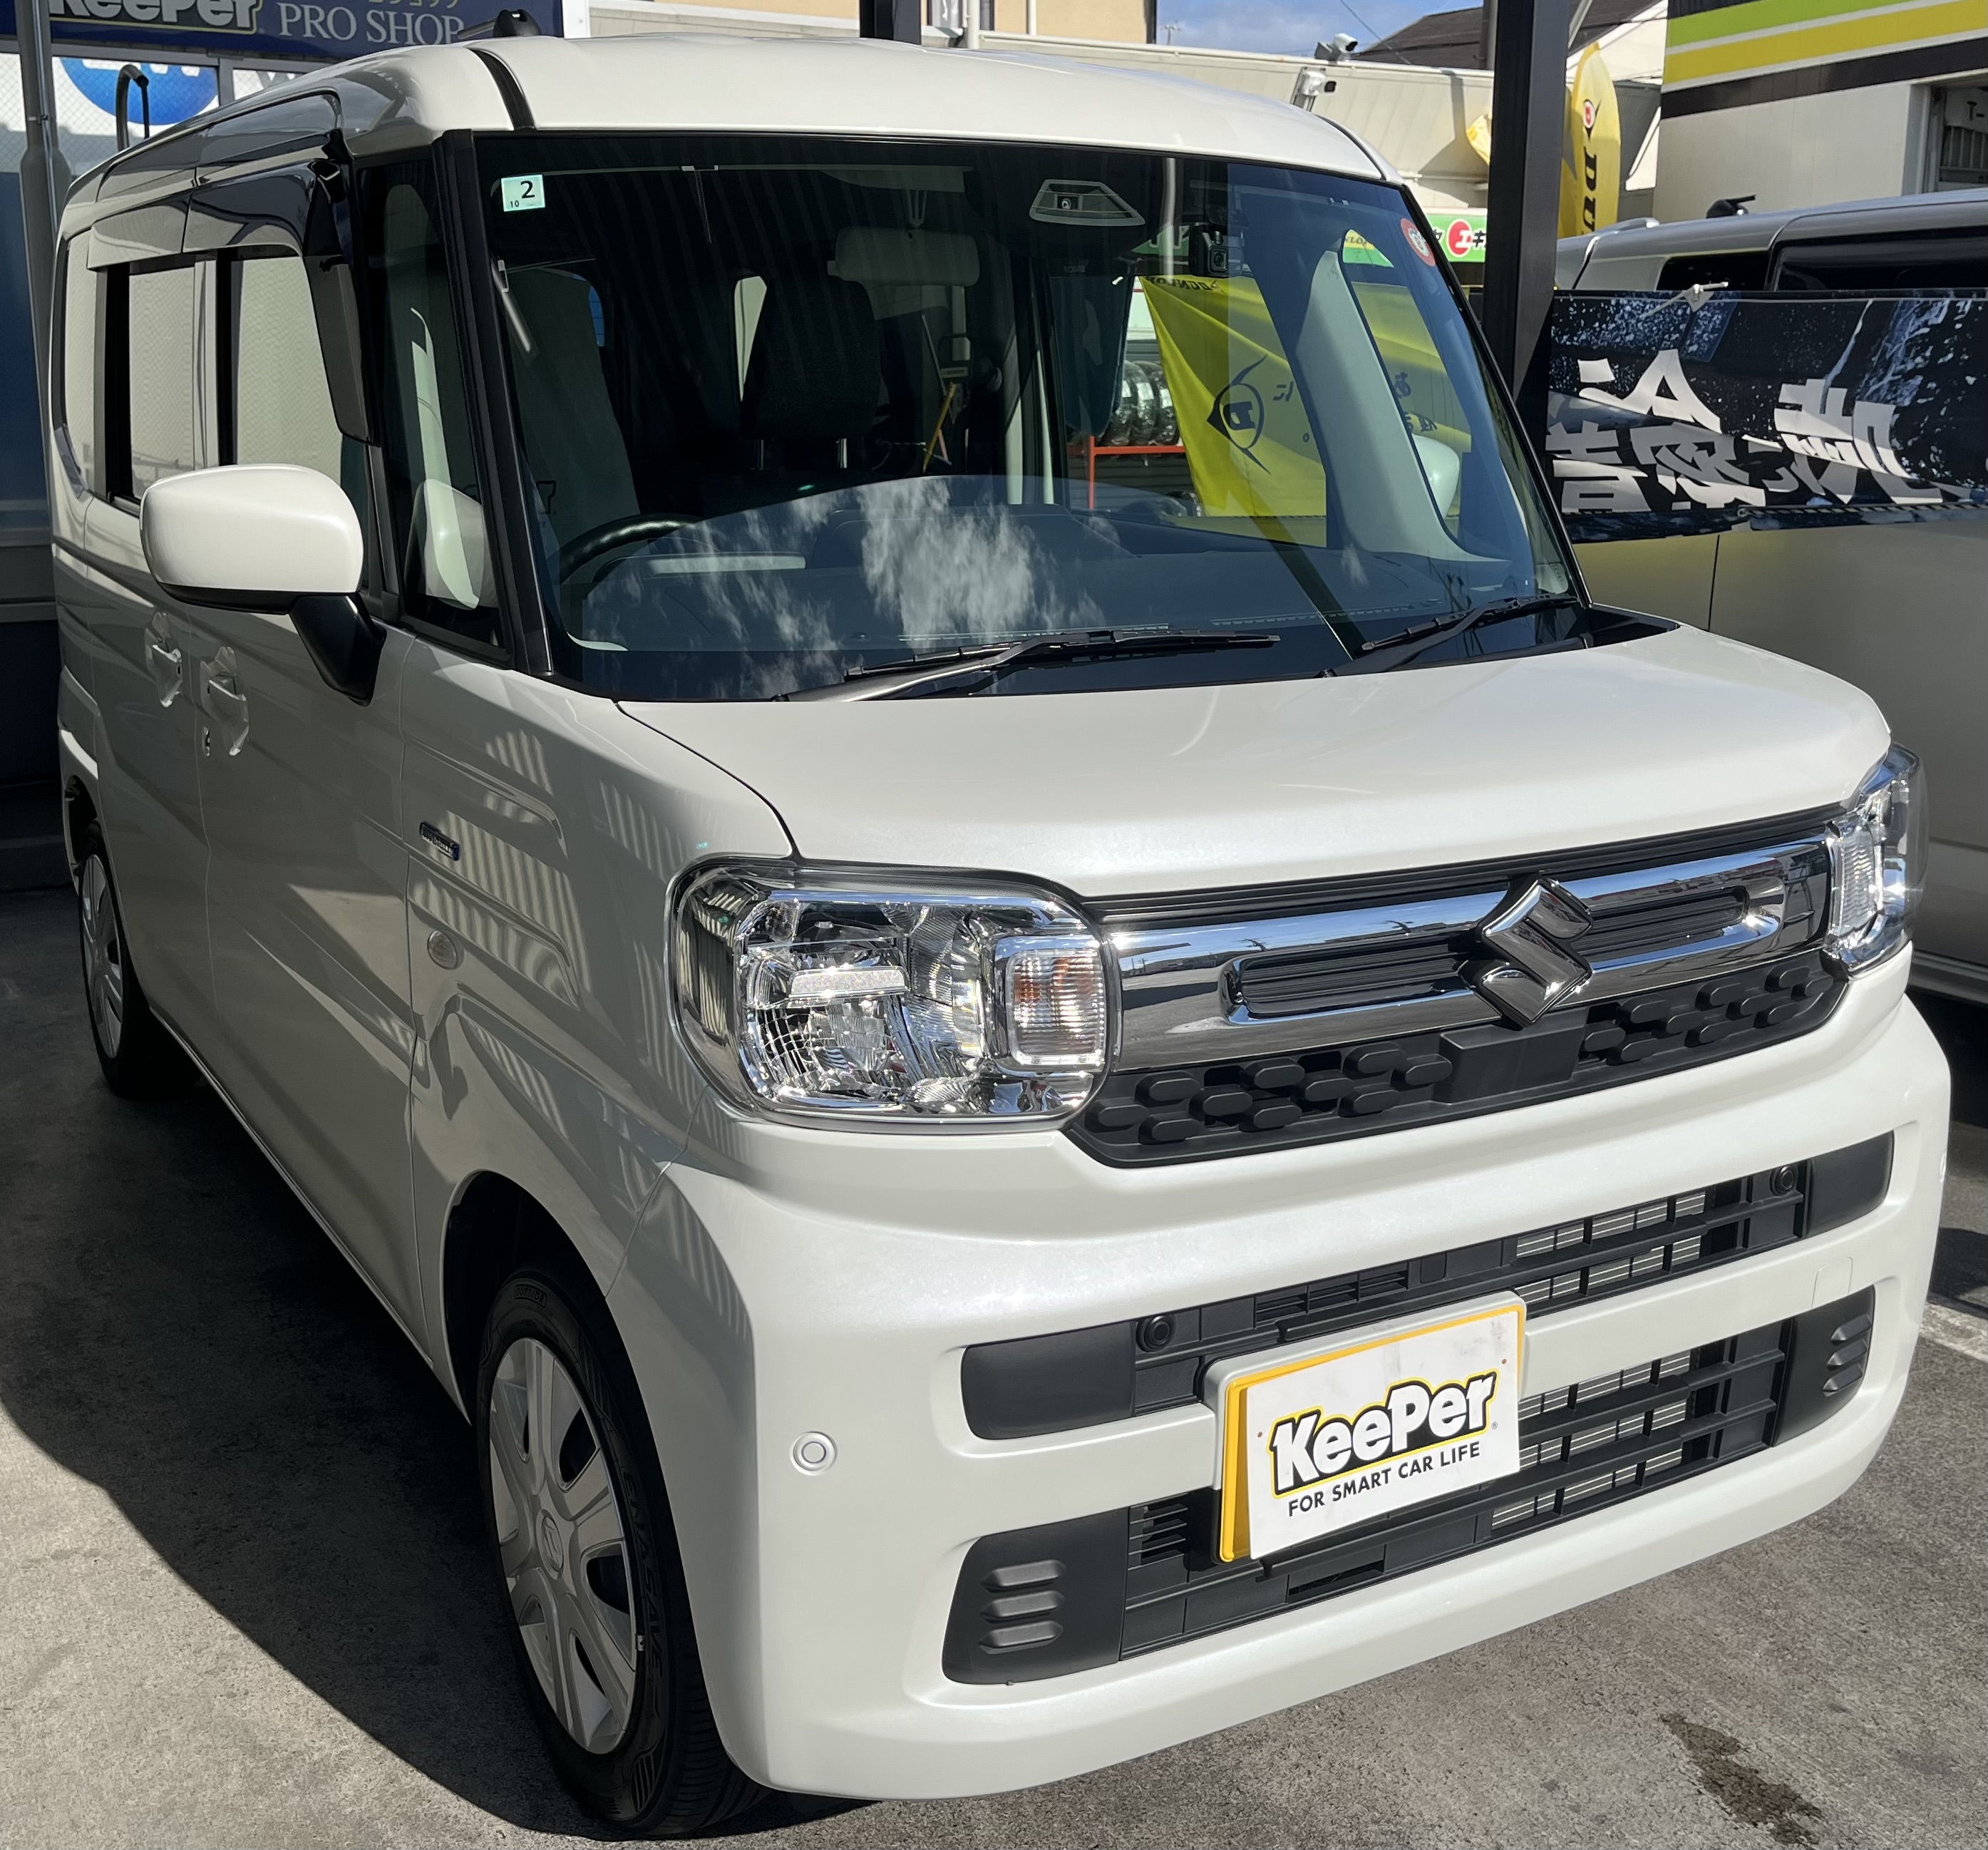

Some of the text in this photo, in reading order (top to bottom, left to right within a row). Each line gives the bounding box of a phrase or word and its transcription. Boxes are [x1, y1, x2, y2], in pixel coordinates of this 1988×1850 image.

[277, 2, 356, 41] PRO
[366, 9, 463, 45] SHOP
[510, 200, 520, 208] 10
[520, 180, 535, 199] 2
[1582, 146, 1597, 236] DU
[1272, 1372, 1497, 1494] KeePer
[1288, 1440, 1480, 1517] FOR SMART CAR LIFE
